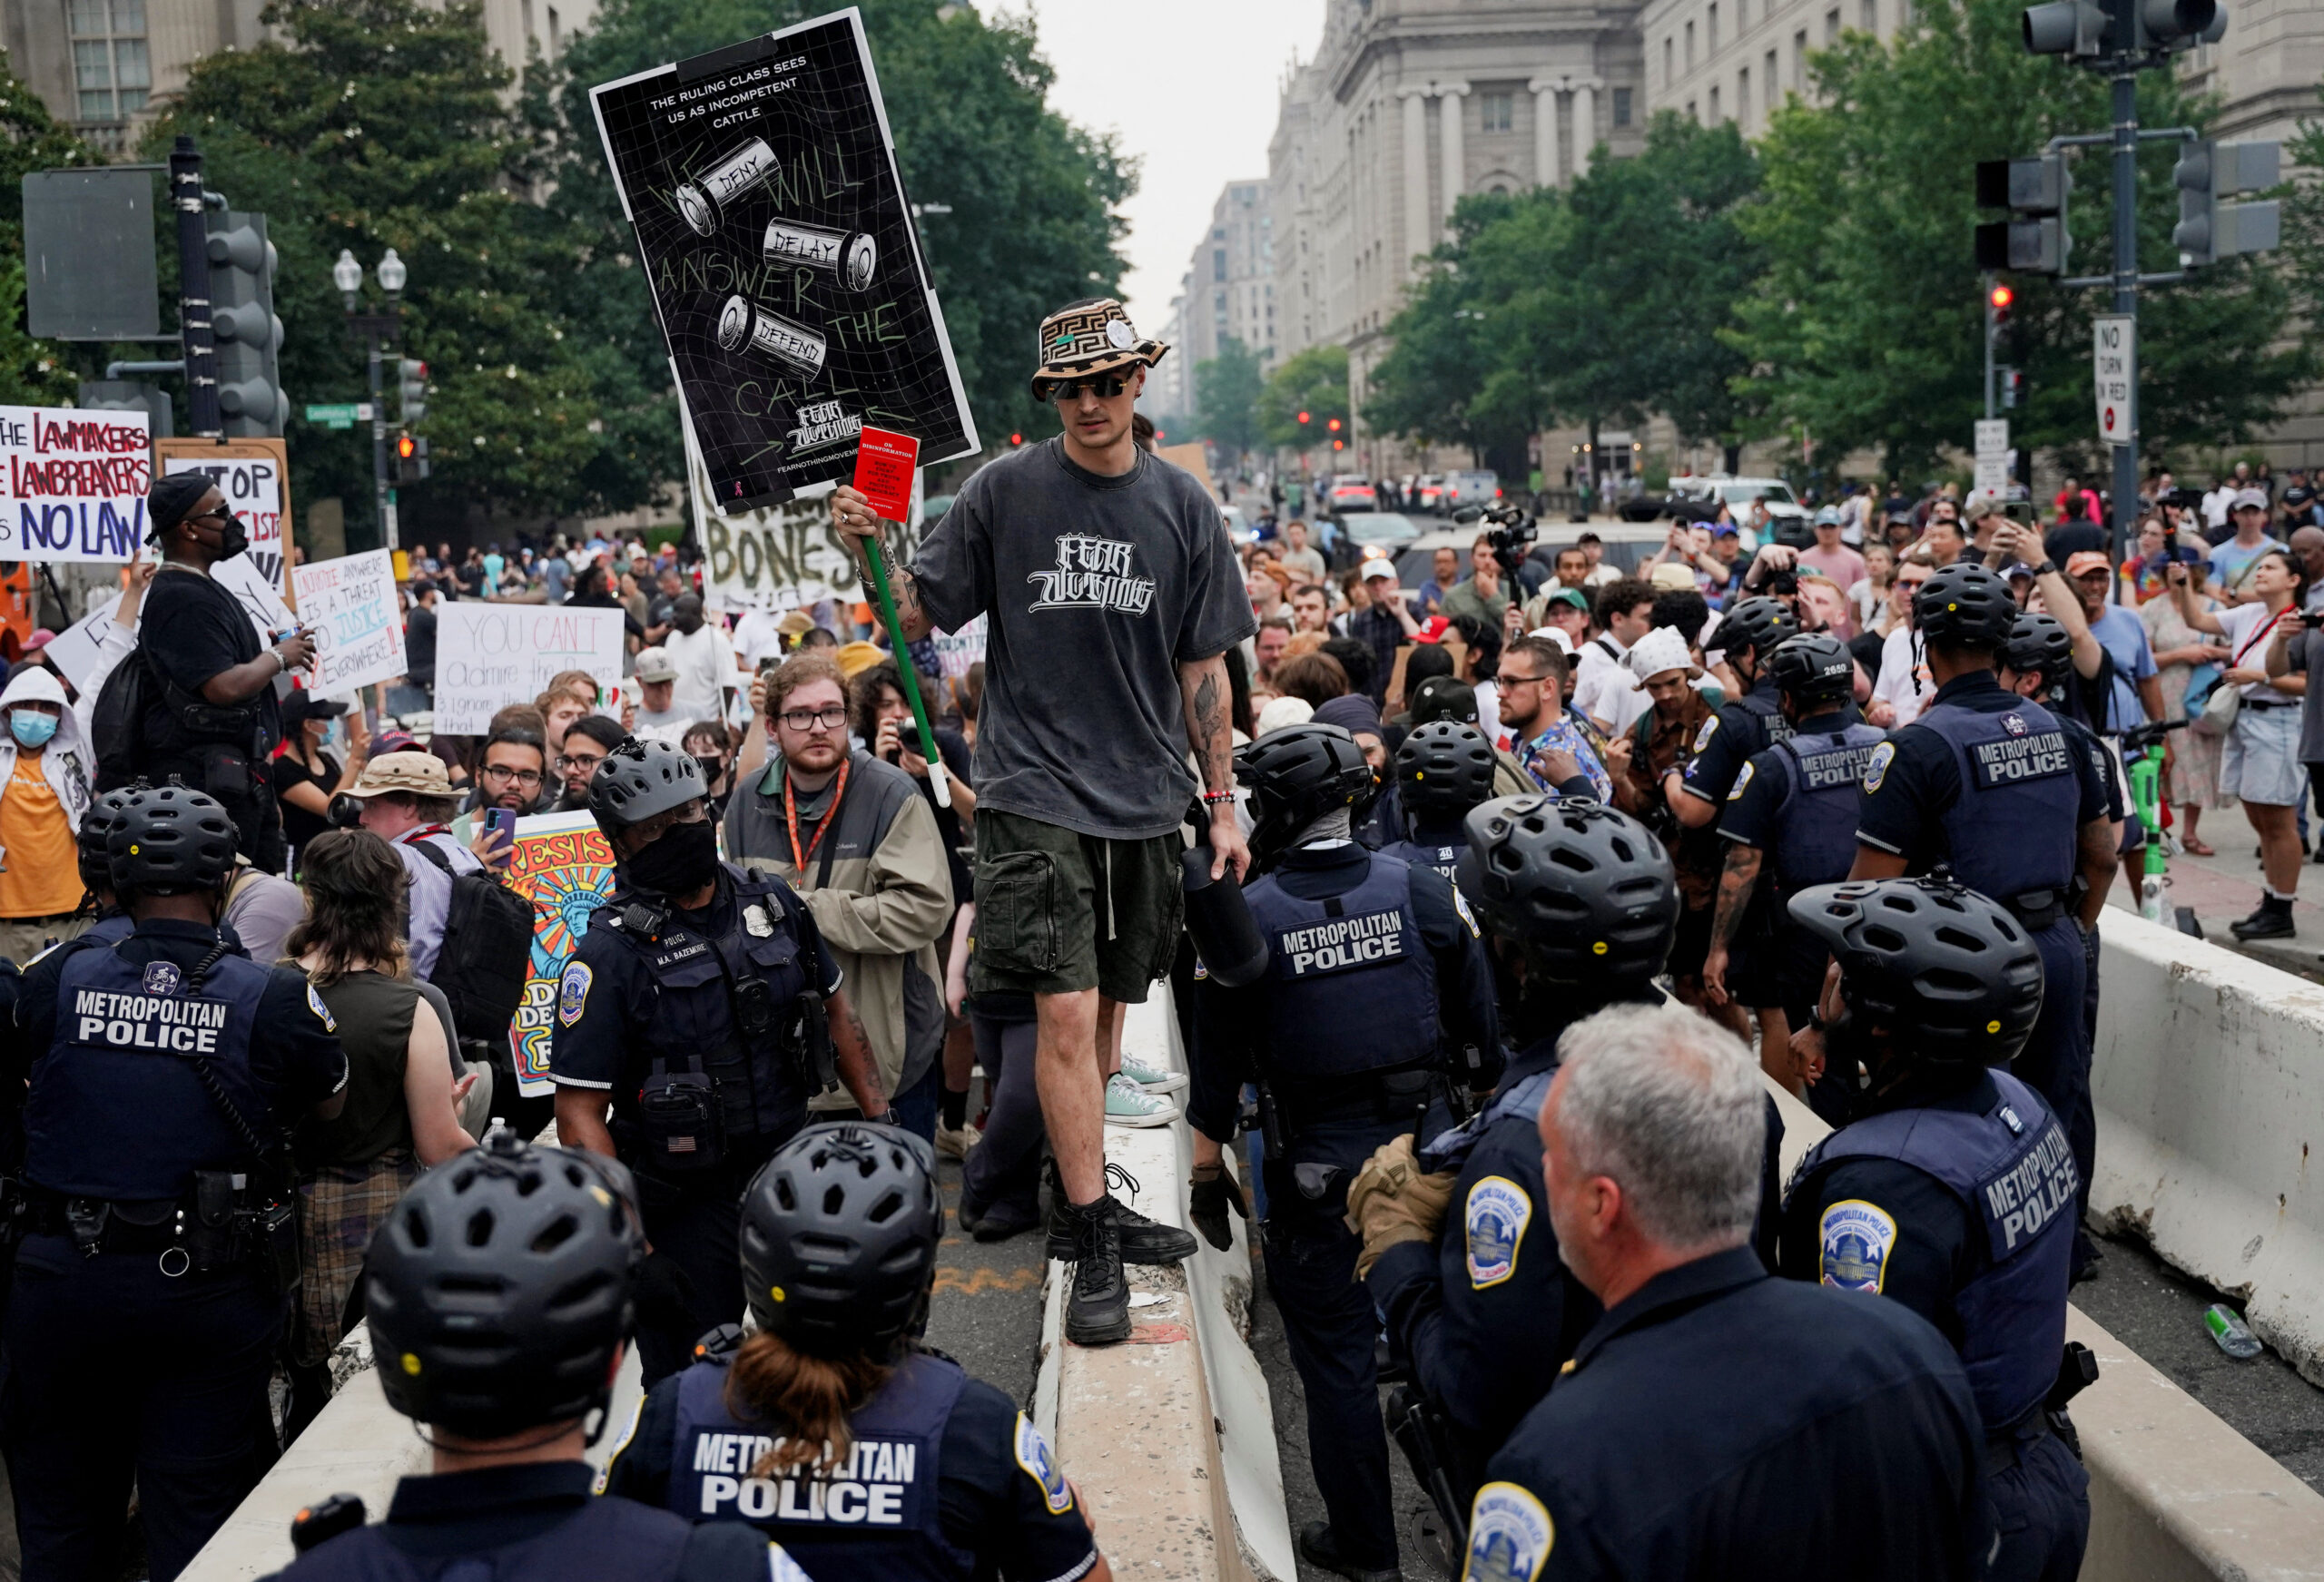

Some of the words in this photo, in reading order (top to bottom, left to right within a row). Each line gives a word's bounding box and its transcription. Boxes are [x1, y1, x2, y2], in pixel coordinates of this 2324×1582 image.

[650, 96, 676, 111] THE
[678, 79, 726, 103] RULING
[729, 67, 770, 87] CLASS
[773, 55, 807, 74] SEES
[667, 109, 686, 123] US
[689, 103, 706, 118] AS
[708, 77, 798, 113] INCOMPETENT
[713, 107, 761, 129] CATTLE
[719, 155, 757, 192] DENY
[756, 142, 864, 211] WILL
[774, 231, 836, 263] DELAY
[661, 252, 826, 313] ANSWER
[758, 320, 819, 362] DEFEND
[826, 302, 905, 349] THE
[2102, 327, 2119, 349] NO
[2100, 356, 2122, 375] TURN
[736, 368, 859, 417] CALL
[2109, 383, 2126, 401] RED
[34, 412, 150, 454] LAWMAKERS
[796, 400, 843, 427] FEAR
[862, 443, 912, 457] DISINFORMATION
[11, 455, 151, 498] LAWBREAKERS
[20, 503, 74, 550] NO
[79, 498, 143, 556] LAW
[705, 516, 858, 591] BONES
[1056, 532, 1136, 577] FEAR
[305, 601, 320, 623] IS
[330, 594, 337, 613] A
[341, 579, 381, 606] THREAT
[334, 599, 389, 641] JUSTICE
[461, 614, 523, 654] YOU
[533, 614, 603, 653] CAN'T
[528, 657, 555, 682] the
[1977, 732, 2066, 763] METROPOLITAN
[1988, 751, 2068, 782] POLICE
[664, 933, 685, 948] POLICE
[673, 944, 706, 960] BAZEMORE
[1282, 910, 1403, 955] METROPOLITAN
[1293, 933, 1402, 975] POLICE
[75, 990, 226, 1028] METROPOLITAN
[150, 984, 165, 993] 44
[78, 1017, 218, 1054] POLICE
[1985, 1123, 2070, 1219] METROPOLITAN
[2003, 1158, 2078, 1250] POLICE
[1867, 1215, 1892, 1240] POLICE
[701, 1475, 904, 1523] POLICE
